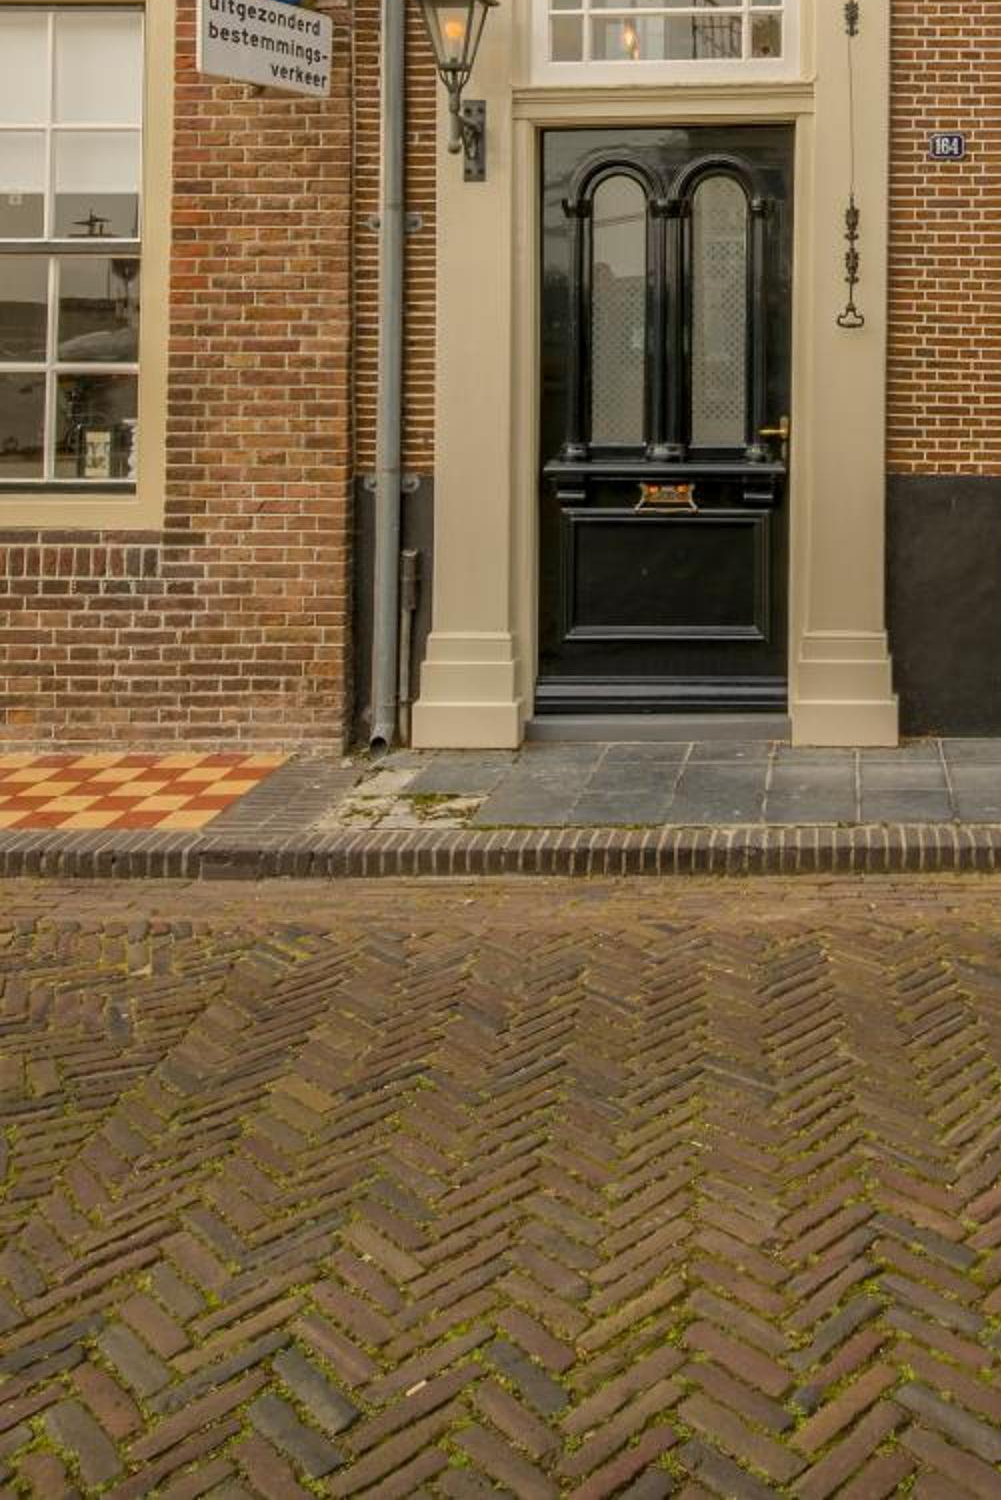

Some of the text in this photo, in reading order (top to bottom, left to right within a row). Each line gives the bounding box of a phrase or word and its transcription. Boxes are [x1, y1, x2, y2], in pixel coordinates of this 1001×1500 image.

[208, 21, 329, 65] bestemmings-
[270, 63, 327, 89] verkeer
[935, 137, 959, 155] 164
